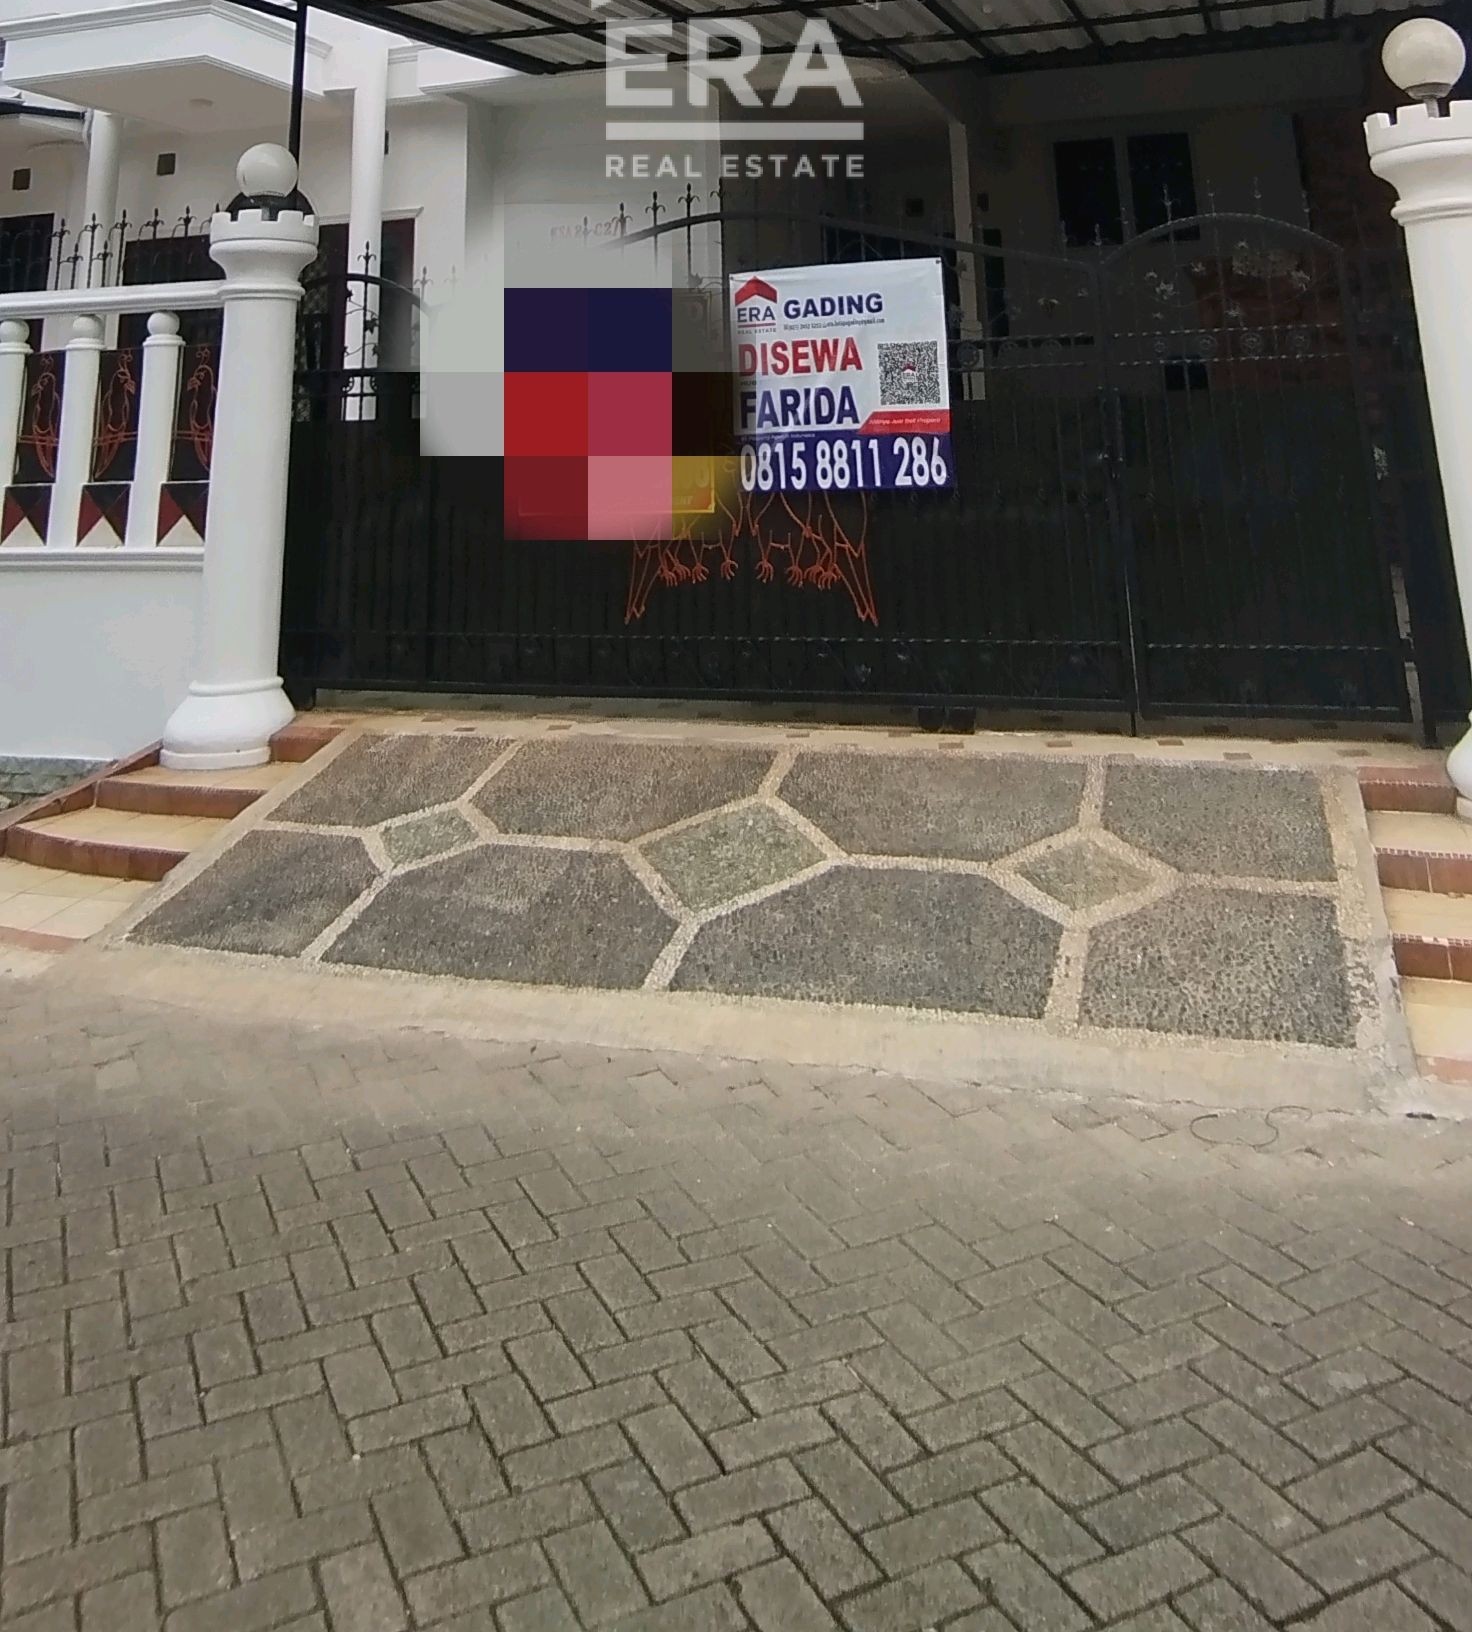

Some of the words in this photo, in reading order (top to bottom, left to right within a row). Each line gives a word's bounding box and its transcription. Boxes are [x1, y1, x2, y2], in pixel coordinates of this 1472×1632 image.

[737, 305, 776, 323] ERA
[784, 293, 883, 319] GADING
[738, 336, 863, 377] DISEWA
[740, 385, 860, 429] FARIDA
[740, 440, 807, 491] 0815
[816, 438, 882, 489] 8811
[893, 436, 947, 486] 286
